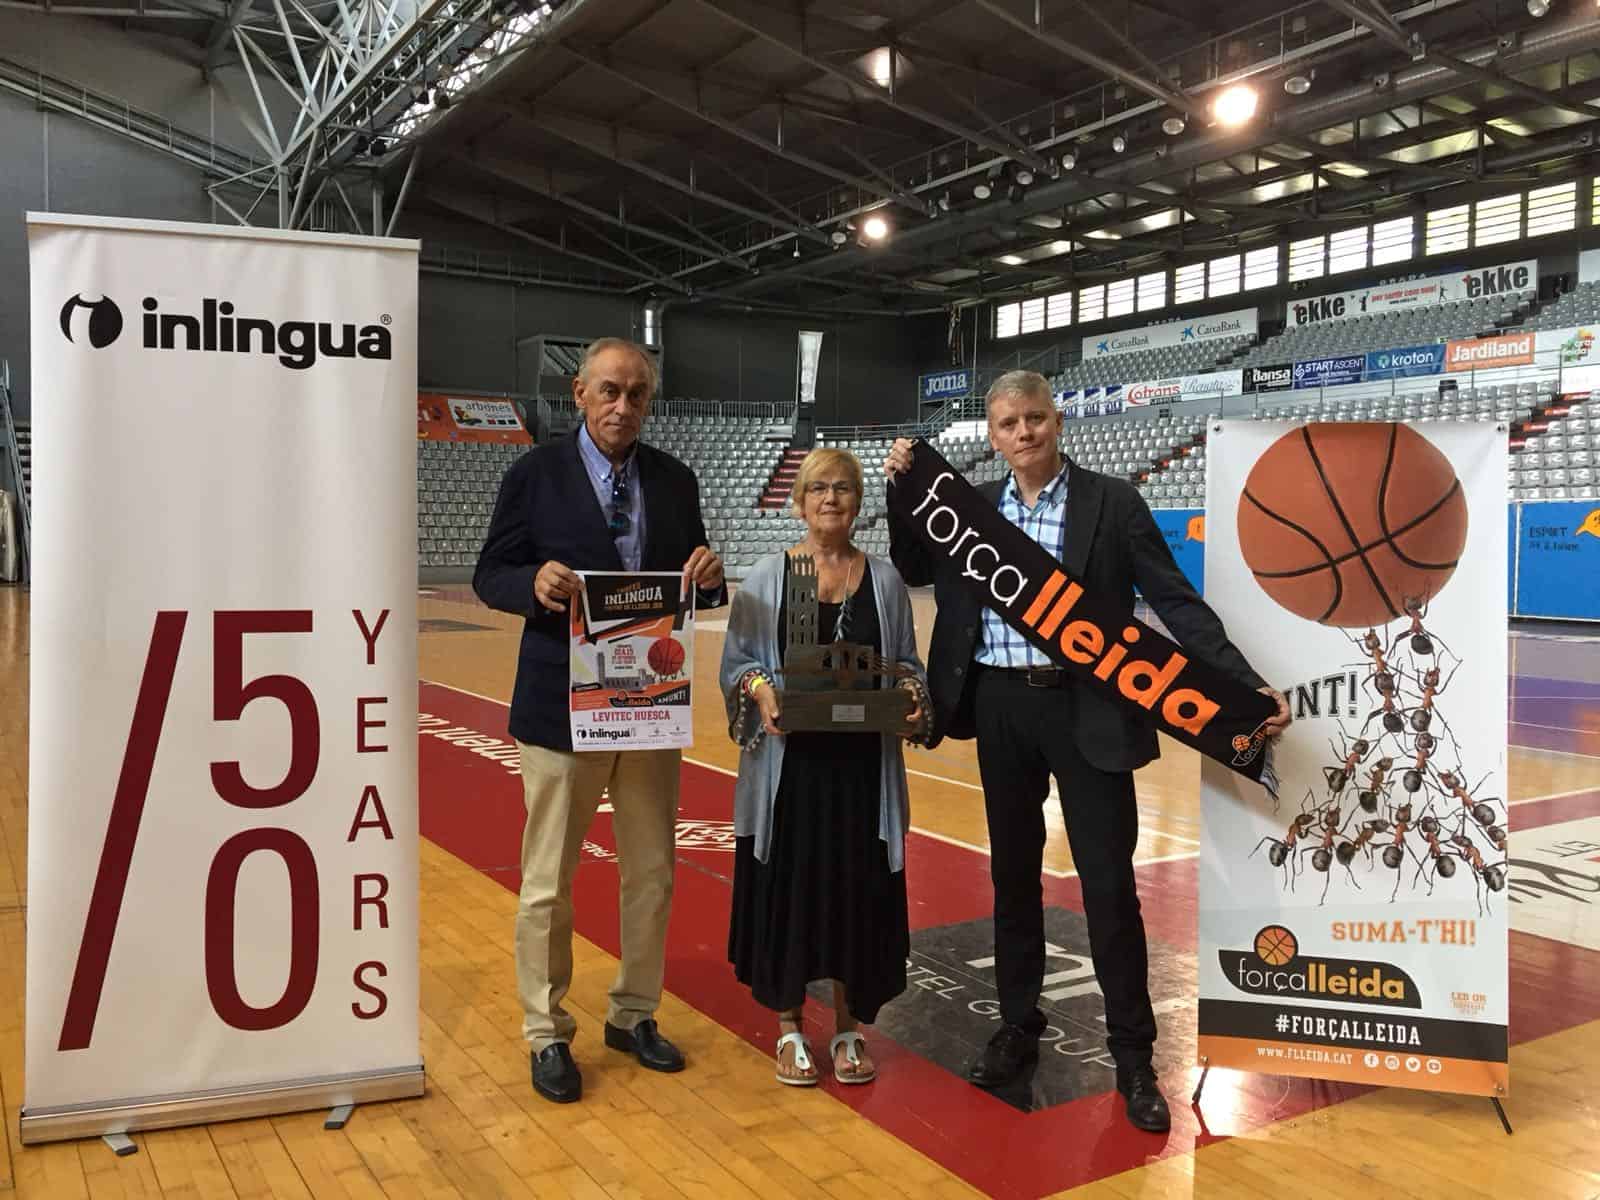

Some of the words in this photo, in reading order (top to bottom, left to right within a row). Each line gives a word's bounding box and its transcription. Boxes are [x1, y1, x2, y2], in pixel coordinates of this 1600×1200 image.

[1295, 295, 1345, 326] ekke
[1391, 351, 1434, 367] kroton
[1451, 337, 1530, 362] Jardiland
[605, 586, 662, 605] INLINGUA
[592, 712, 633, 722] LEVITEC
[634, 710, 671, 722] HUESCA
[589, 728, 631, 740] inlingua
[346, 609, 395, 1021] YEARS
[1331, 919, 1477, 946] SUMA-T'HI!
[1275, 1013, 1421, 1046] #FORÇALLEIDA
